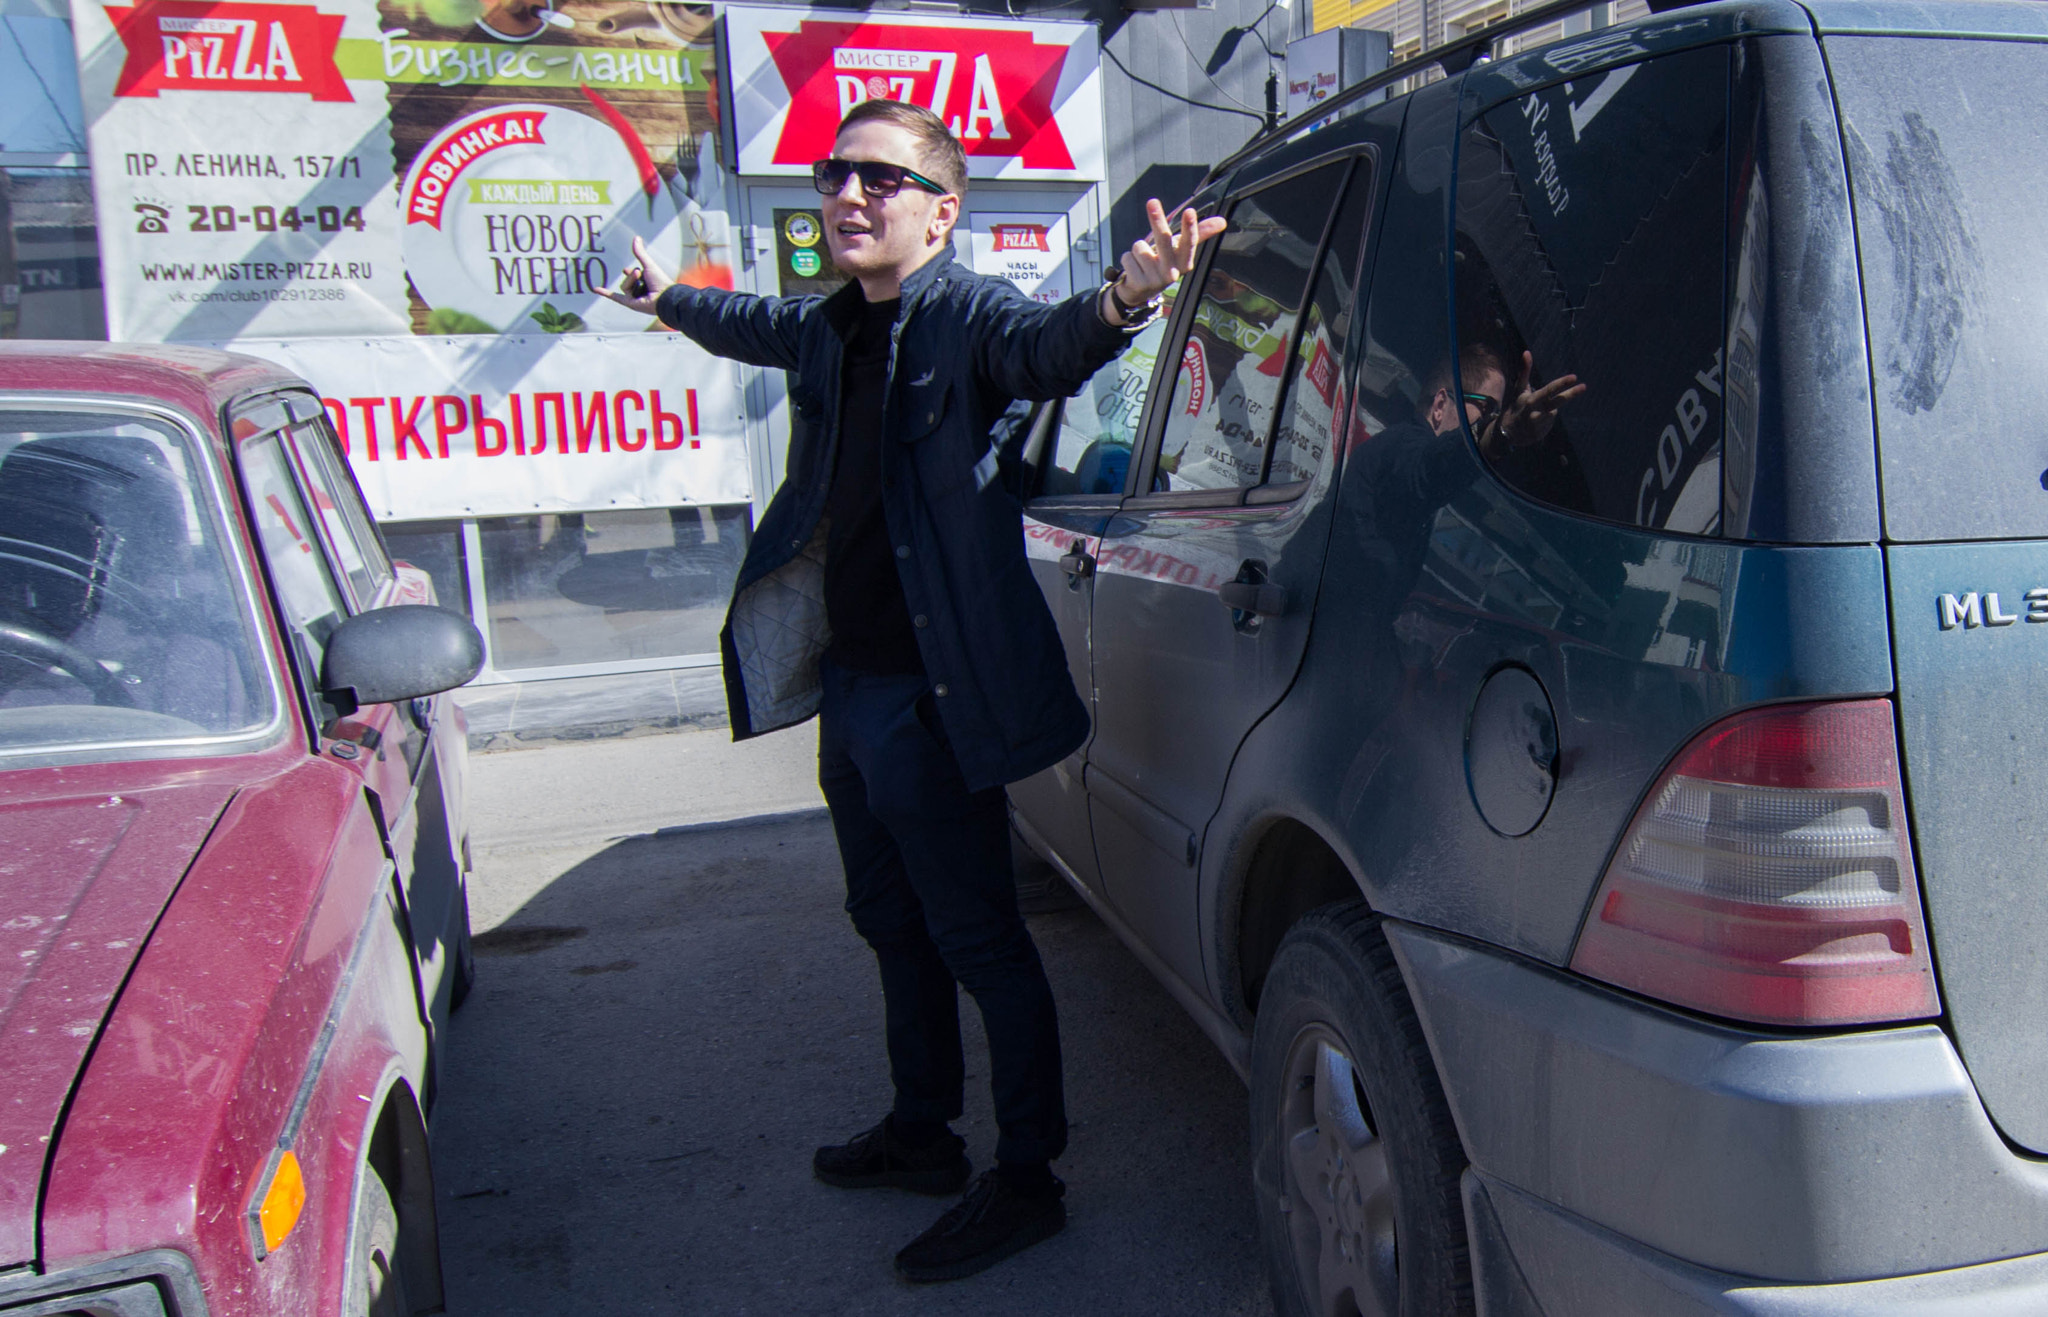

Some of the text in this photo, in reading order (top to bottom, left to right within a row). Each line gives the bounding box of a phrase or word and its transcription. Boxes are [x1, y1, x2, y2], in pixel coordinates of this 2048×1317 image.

[162, 19, 228, 31] МИСТЕР
[377, 28, 695, 87] Бизнес-ланчи
[837, 51, 920, 68] МИСТЕР
[126, 153, 361, 180] ПР. ЛЕНИНА, 157/1
[413, 119, 534, 217] НОВИНКА!
[481, 182, 600, 205] КАЖДЫЙ ДЕНЬ
[188, 205, 366, 232] 20-04-04
[484, 214, 606, 253] НОВОЕ
[141, 262, 372, 281] WWW.MISTER-PIZZA.RU
[490, 256, 609, 295] МЕНЮ
[1007, 262, 1038, 270] ЧАСЫ
[169, 288, 346, 303] vk.com/club102912386
